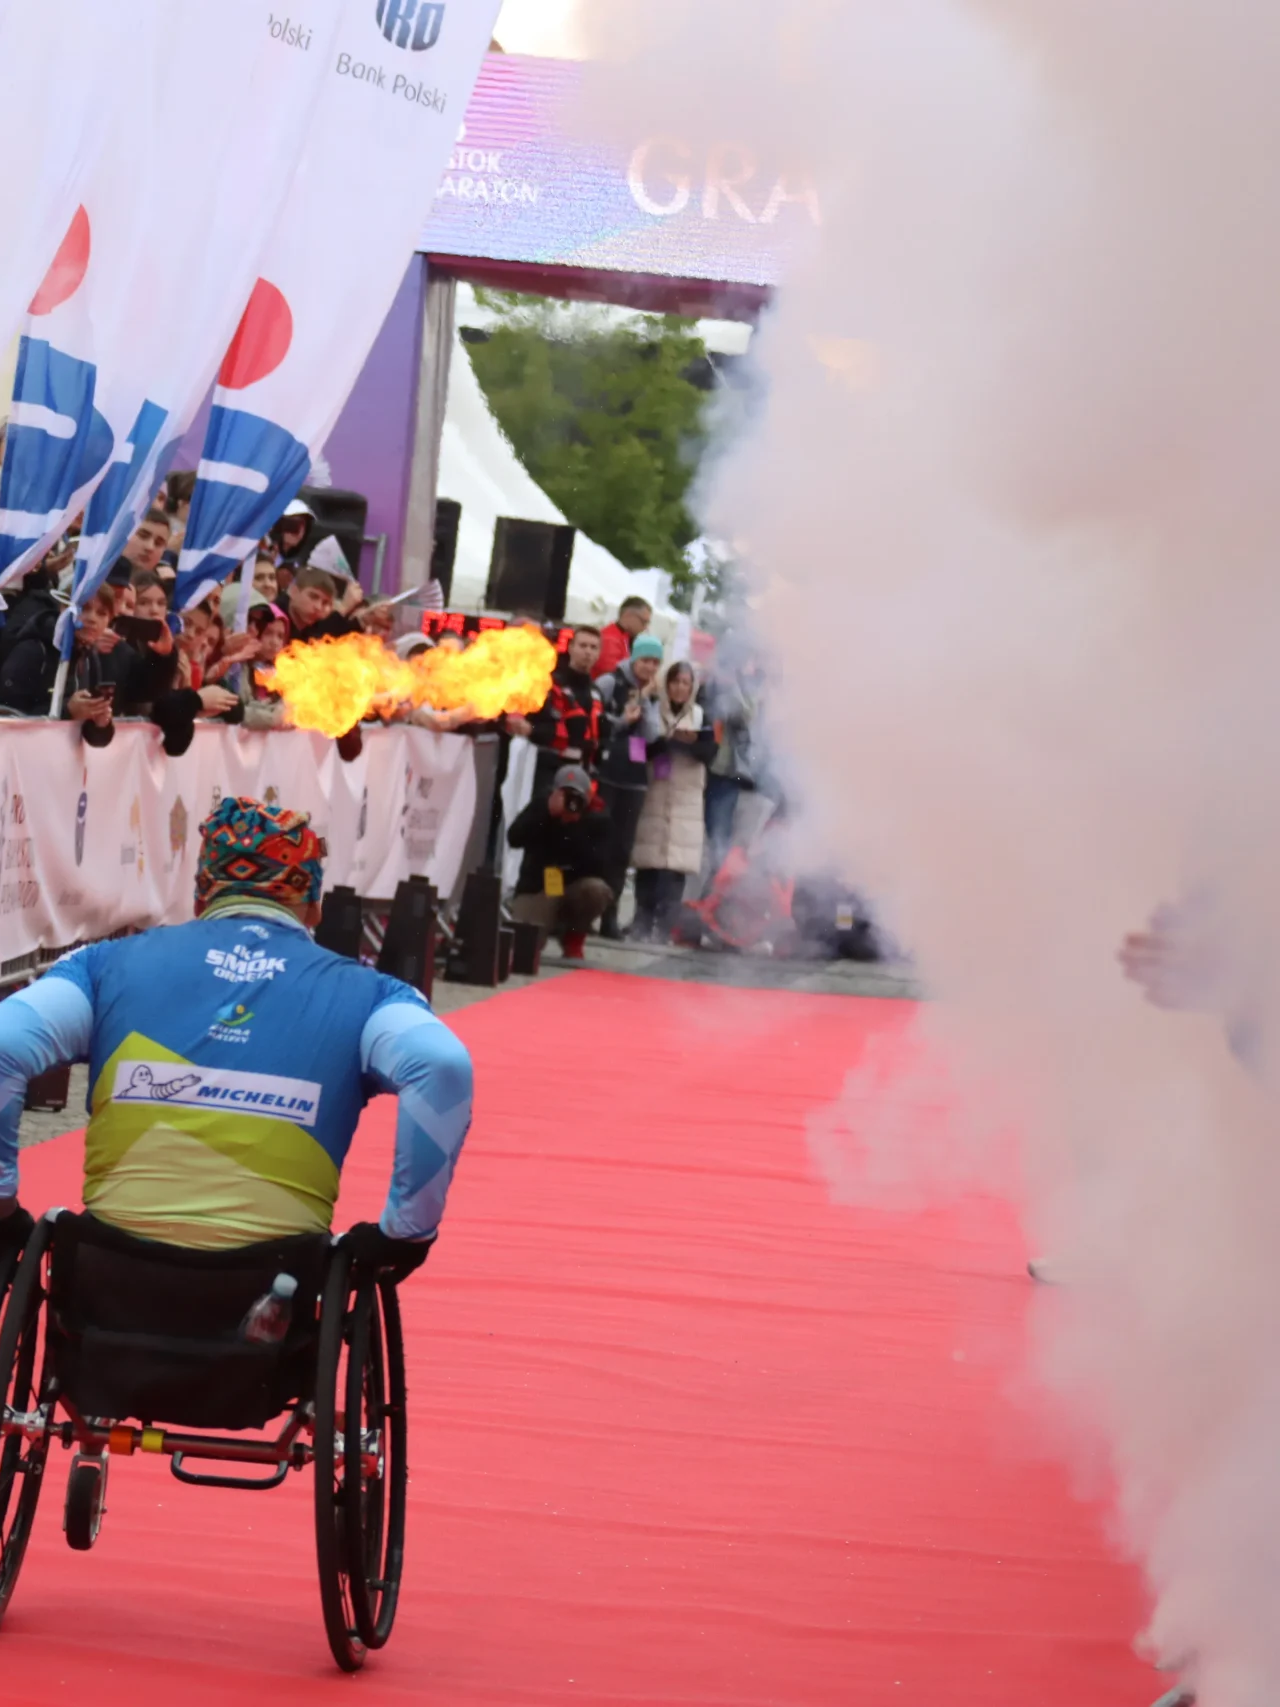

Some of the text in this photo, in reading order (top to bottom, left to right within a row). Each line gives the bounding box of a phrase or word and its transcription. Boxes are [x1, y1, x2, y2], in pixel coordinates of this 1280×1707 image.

[376, 0, 445, 52] KO
[335, 52, 448, 114] Bank Polski
[436, 176, 538, 203] ARATON
[205, 949, 287, 974] SMOK
[197, 1086, 314, 1113] MICHELIN
